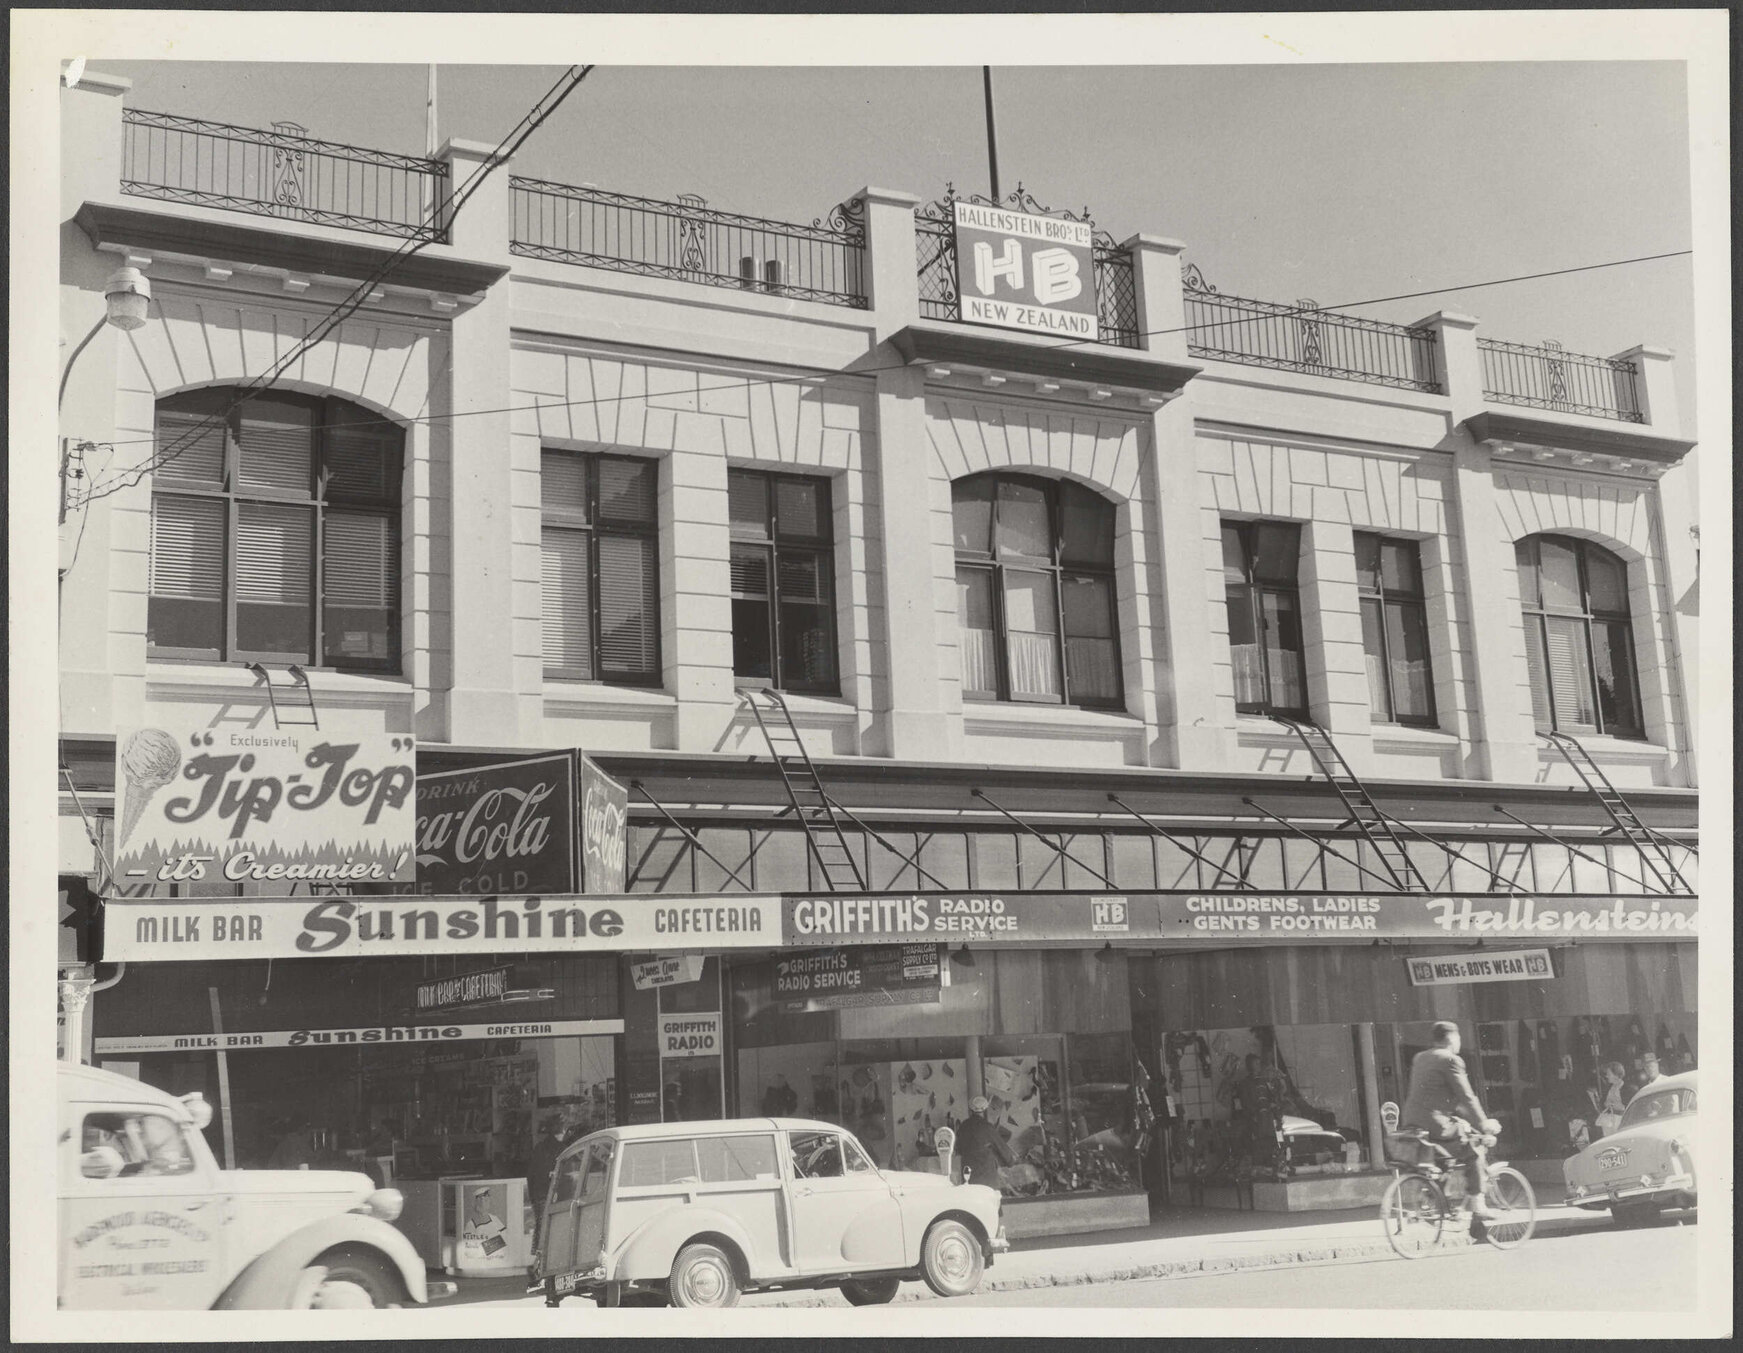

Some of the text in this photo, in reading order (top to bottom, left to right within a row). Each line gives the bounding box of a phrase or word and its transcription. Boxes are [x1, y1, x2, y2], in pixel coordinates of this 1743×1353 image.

[958, 206, 1042, 236] HALLENSTEIN
[971, 300, 1091, 334] NEW ZEALAND
[230, 733, 300, 754] Exclusively
[416, 778, 480, 801] DRINK
[416, 782, 558, 864] ca-Cola
[458, 870, 529, 895] COLD
[794, 895, 930, 935] GRIFFITH'S
[940, 898, 1005, 914] RADIO
[1186, 897, 1380, 914] CHILDRENS, LADIES
[136, 914, 264, 943] MILK BAR
[295, 895, 624, 953] Sunshine
[654, 907, 763, 934] CAFETERIA
[934, 915, 1018, 932] SERVICE
[1193, 915, 1377, 931] GENTS FOOTWEAR
[902, 943, 938, 956] TRAFALGAR
[789, 953, 848, 975] GRIFFITH'S
[902, 955, 922, 967] SUPPLY
[1434, 963, 1460, 978] MENS
[1466, 961, 1492, 976] BOYS
[1492, 958, 1524, 974] WEAR
[777, 970, 862, 992] RADIO SERVICE
[287, 1025, 463, 1046] Sunshine
[486, 1023, 553, 1036] CAFETERIA
[663, 1021, 716, 1034] GRIFFITH
[174, 1036, 218, 1049] MILK
[226, 1035, 264, 1046] BAR
[667, 1035, 715, 1051] RADIO
